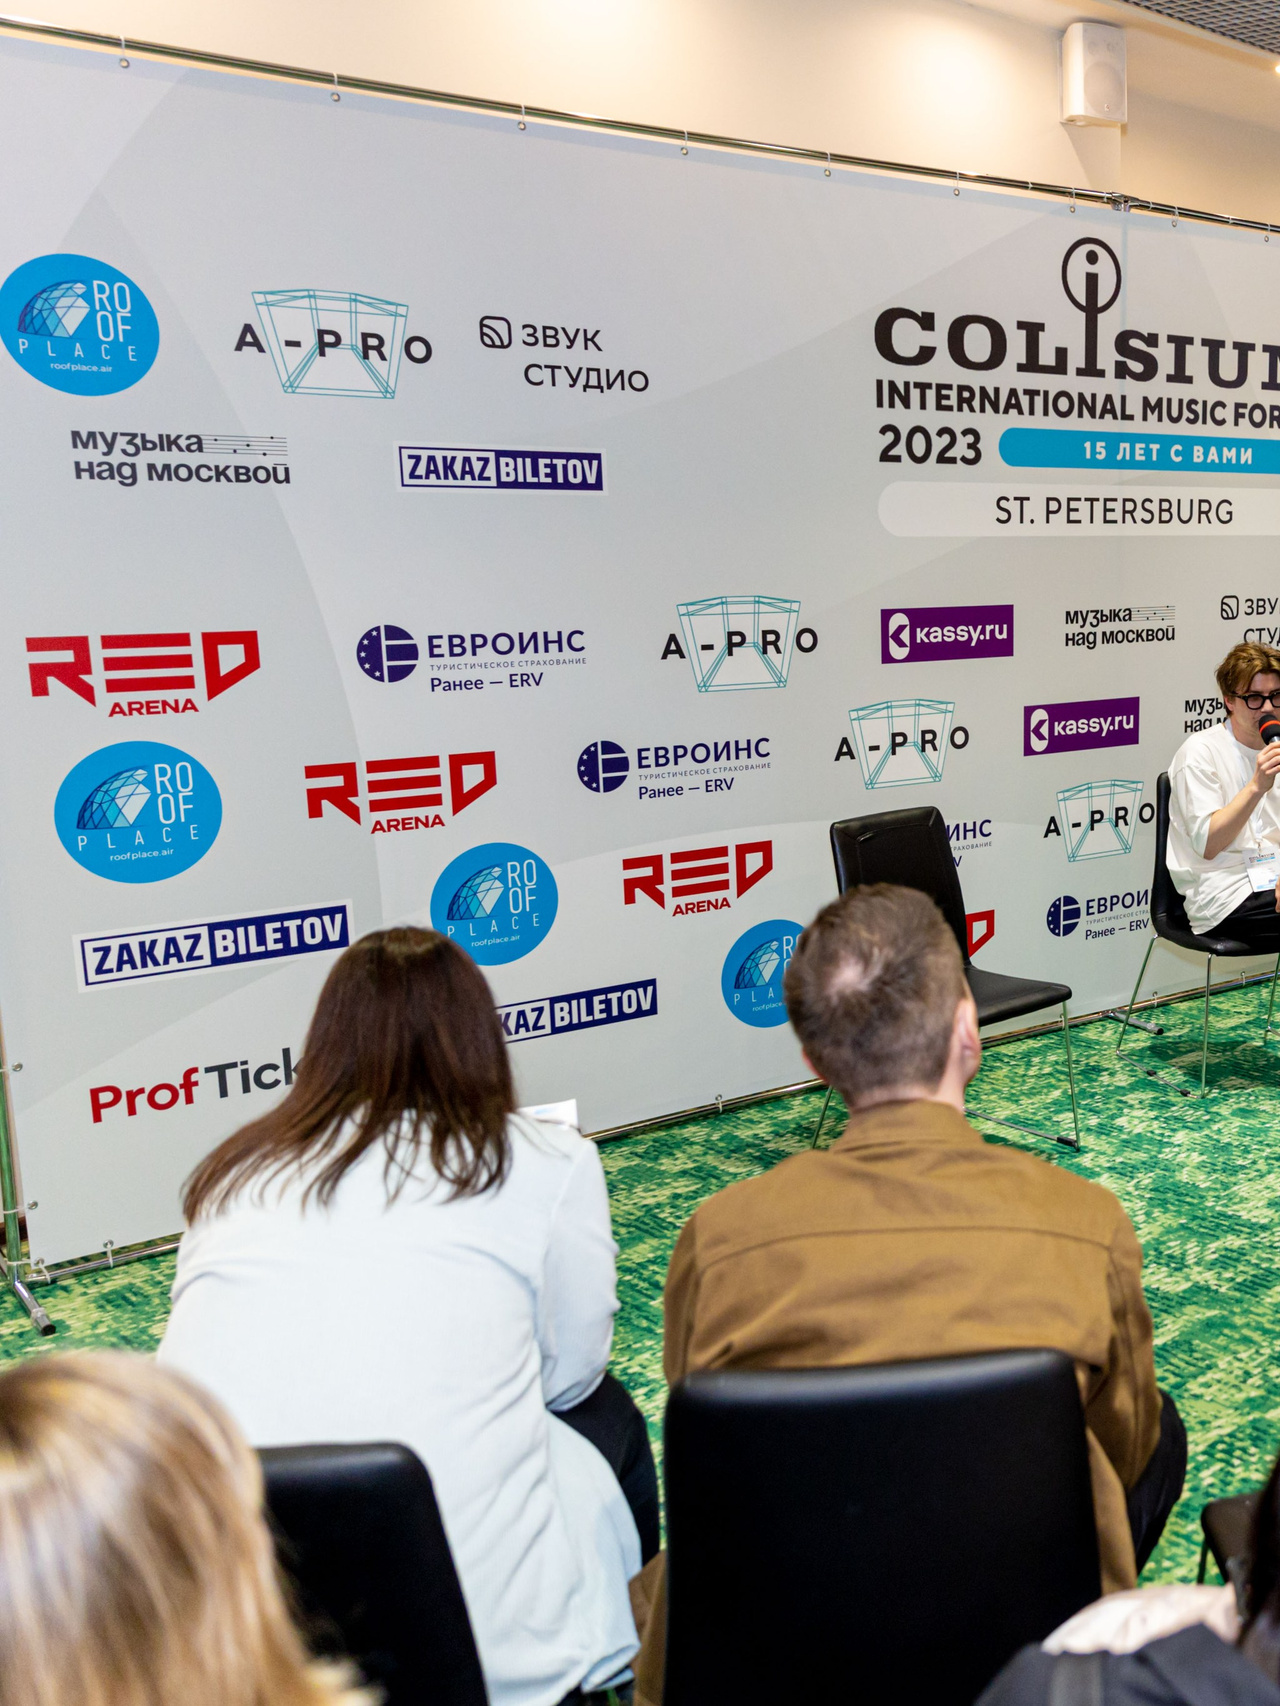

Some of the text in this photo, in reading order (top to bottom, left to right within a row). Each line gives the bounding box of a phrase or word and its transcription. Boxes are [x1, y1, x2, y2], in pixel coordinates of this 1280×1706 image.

[93, 280, 132, 313] RO
[96, 310, 132, 342] OF
[521, 323, 603, 352] ЗВУК
[18, 338, 137, 361] PLACE
[50, 363, 112, 373] roofplace.air
[523, 363, 649, 393] СТУДИО
[875, 378, 1135, 422] INTERNATIONAL
[1142, 395, 1227, 426] MUSIC
[70, 430, 204, 457] музыка
[878, 423, 983, 467] 2023
[1083, 440, 1253, 466] 15 ЛЕТ С ВАМИ
[74, 460, 291, 487] над москвой
[406, 453, 599, 484] ZAKAZ BILETOV
[995, 495, 1234, 526] ST. PETERSBURG
[1065, 608, 1132, 629] музыка
[427, 629, 586, 658] ЕВРОИНС
[916, 622, 1008, 646] kassy.ru
[1065, 625, 1175, 650] над москвой
[25, 630, 261, 708] RED
[430, 657, 587, 672] ТУРИСТИЧЕСКОЕ СТРАХОВАНИЕ
[430, 676, 485, 692] Ранее
[509, 672, 544, 688] ERV
[108, 698, 199, 717] ARENA
[1185, 697, 1226, 717] музы
[1053, 714, 1134, 737] kassy.ru
[637, 737, 771, 769] ЕВРОИНС
[154, 761, 194, 794] RO
[638, 762, 772, 781] ТУРИСТИЧЕСКОЕ СТРАХОВАНИЕ
[304, 750, 497, 826] RED
[639, 783, 684, 799] Ранее
[705, 777, 735, 793] ERV
[157, 792, 194, 825] OF
[77, 824, 199, 851] PLACE
[370, 814, 446, 835] ARENA
[110, 848, 174, 862] roofplace.air
[952, 841, 992, 851] РАХОВАНИЕ
[507, 859, 537, 888] RO
[622, 840, 773, 909] RED
[508, 885, 537, 914] OF
[672, 896, 732, 917] ARENA
[1086, 889, 1149, 917] ЕВРОИ
[447, 913, 540, 938] PLACE
[1085, 927, 1116, 940] Ранее
[1129, 918, 1150, 932] ERV
[92, 913, 343, 976] ZAKAZ BILETOV
[733, 987, 775, 1006] PLA
[499, 985, 654, 1037] KAZ BILETOV
[89, 1046, 300, 1124] ProfTick
